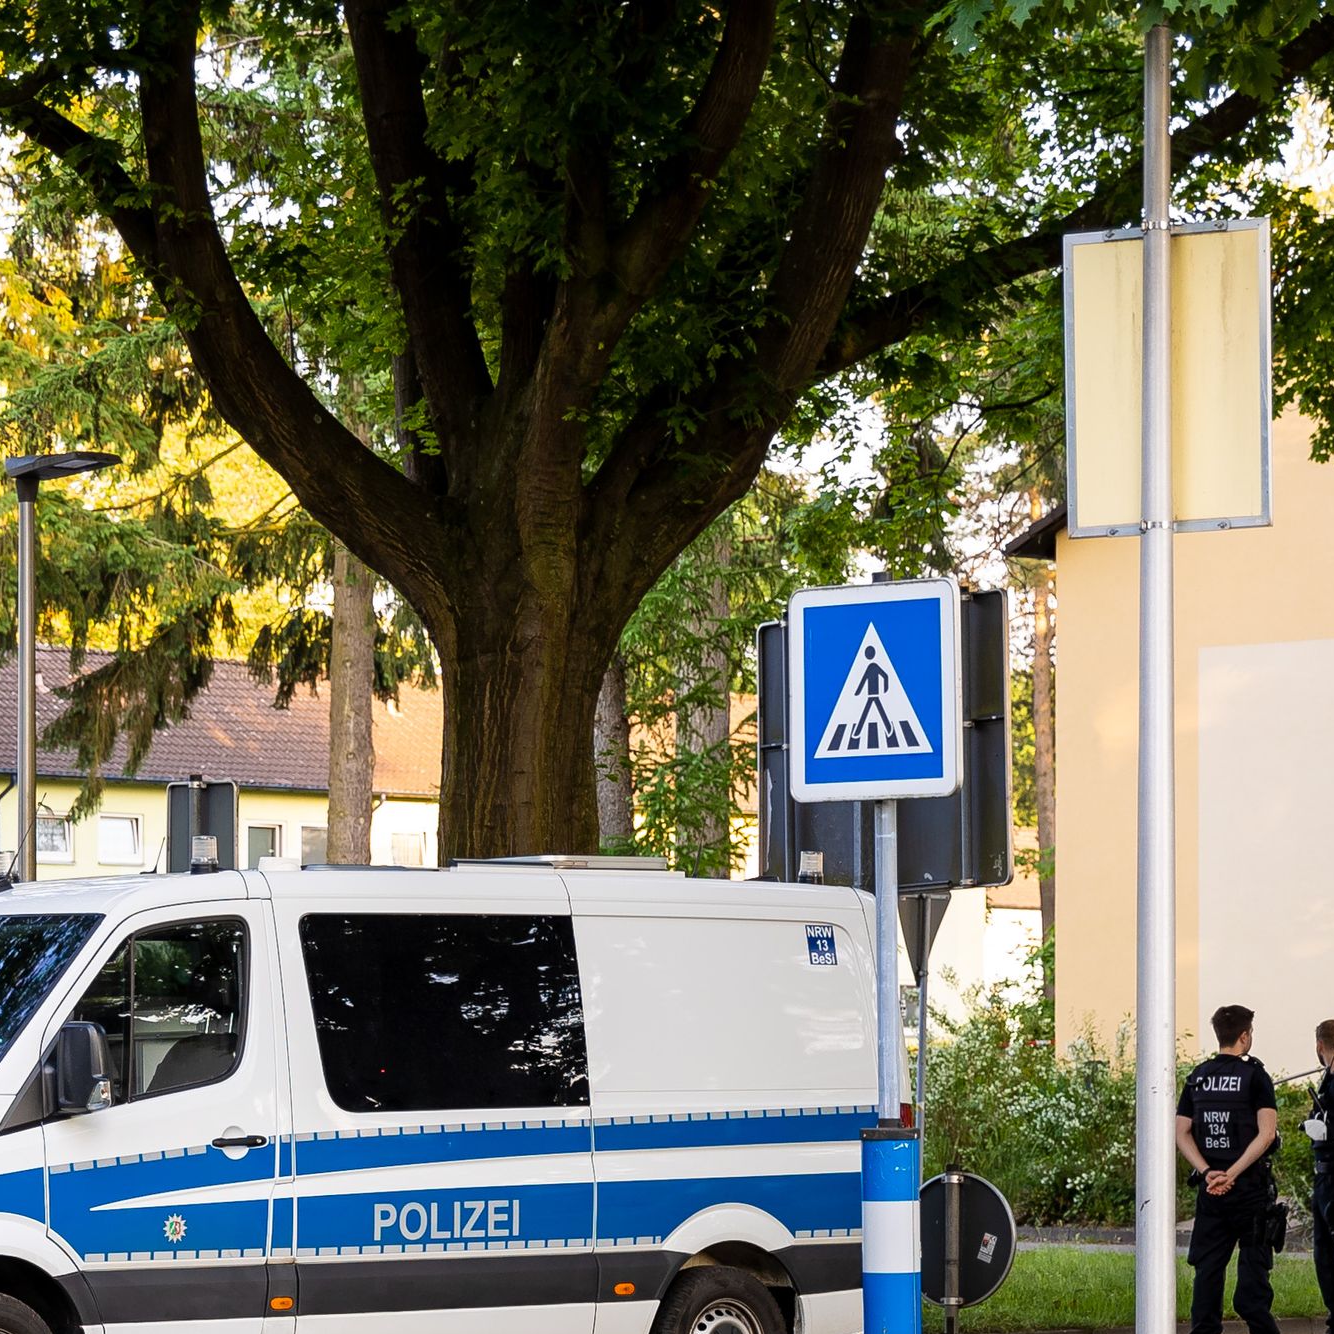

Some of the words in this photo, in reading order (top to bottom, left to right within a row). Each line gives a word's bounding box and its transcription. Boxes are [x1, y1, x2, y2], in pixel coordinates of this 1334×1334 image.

[807, 926, 832, 938] NRW
[816, 939, 829, 951] 13
[811, 952, 836, 964] BeSi
[1204, 1111, 1230, 1123] NRW
[1208, 1124, 1226, 1135] 134
[1206, 1137, 1230, 1148] BeSi
[374, 1199, 520, 1241] POLIZEI
